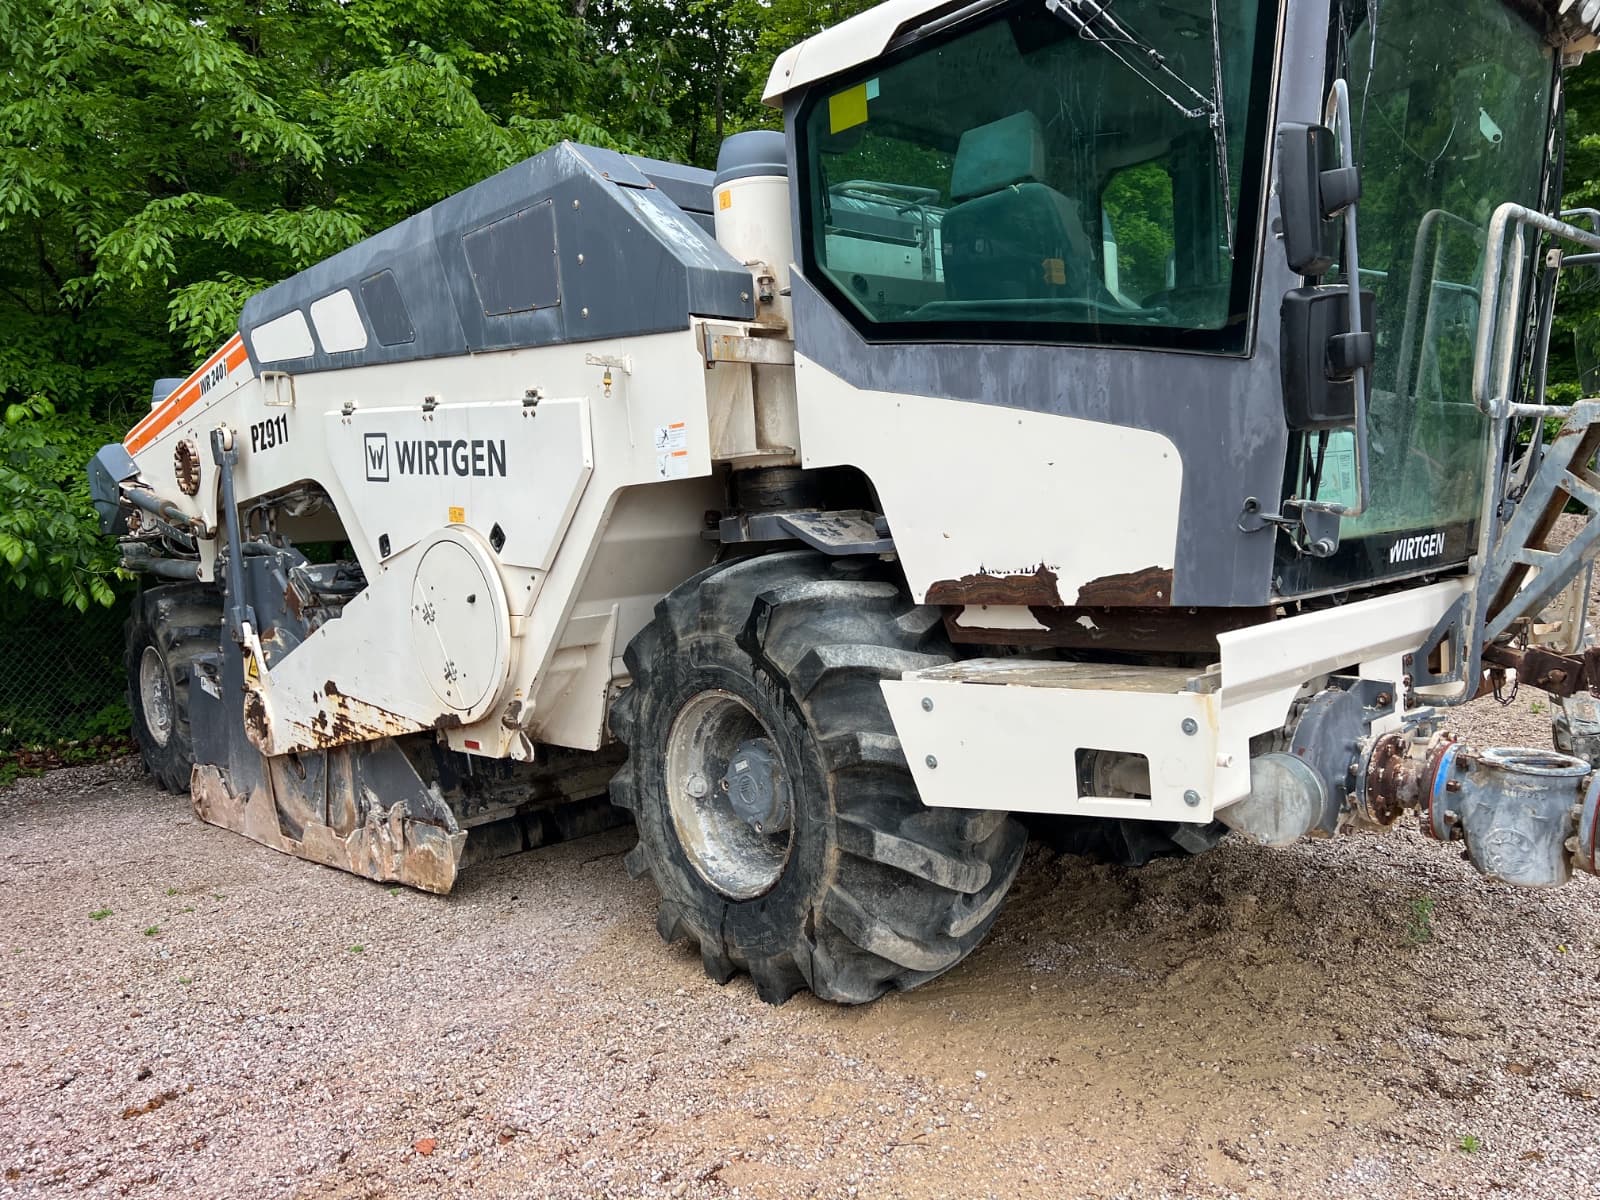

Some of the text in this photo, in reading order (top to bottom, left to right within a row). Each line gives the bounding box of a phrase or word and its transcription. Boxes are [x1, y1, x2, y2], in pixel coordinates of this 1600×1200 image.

[199, 374, 211, 396] WR
[250, 412, 289, 454] PZ911
[395, 439, 507, 477] WIRTGEN
[1389, 532, 1446, 564] WIRTGEN
